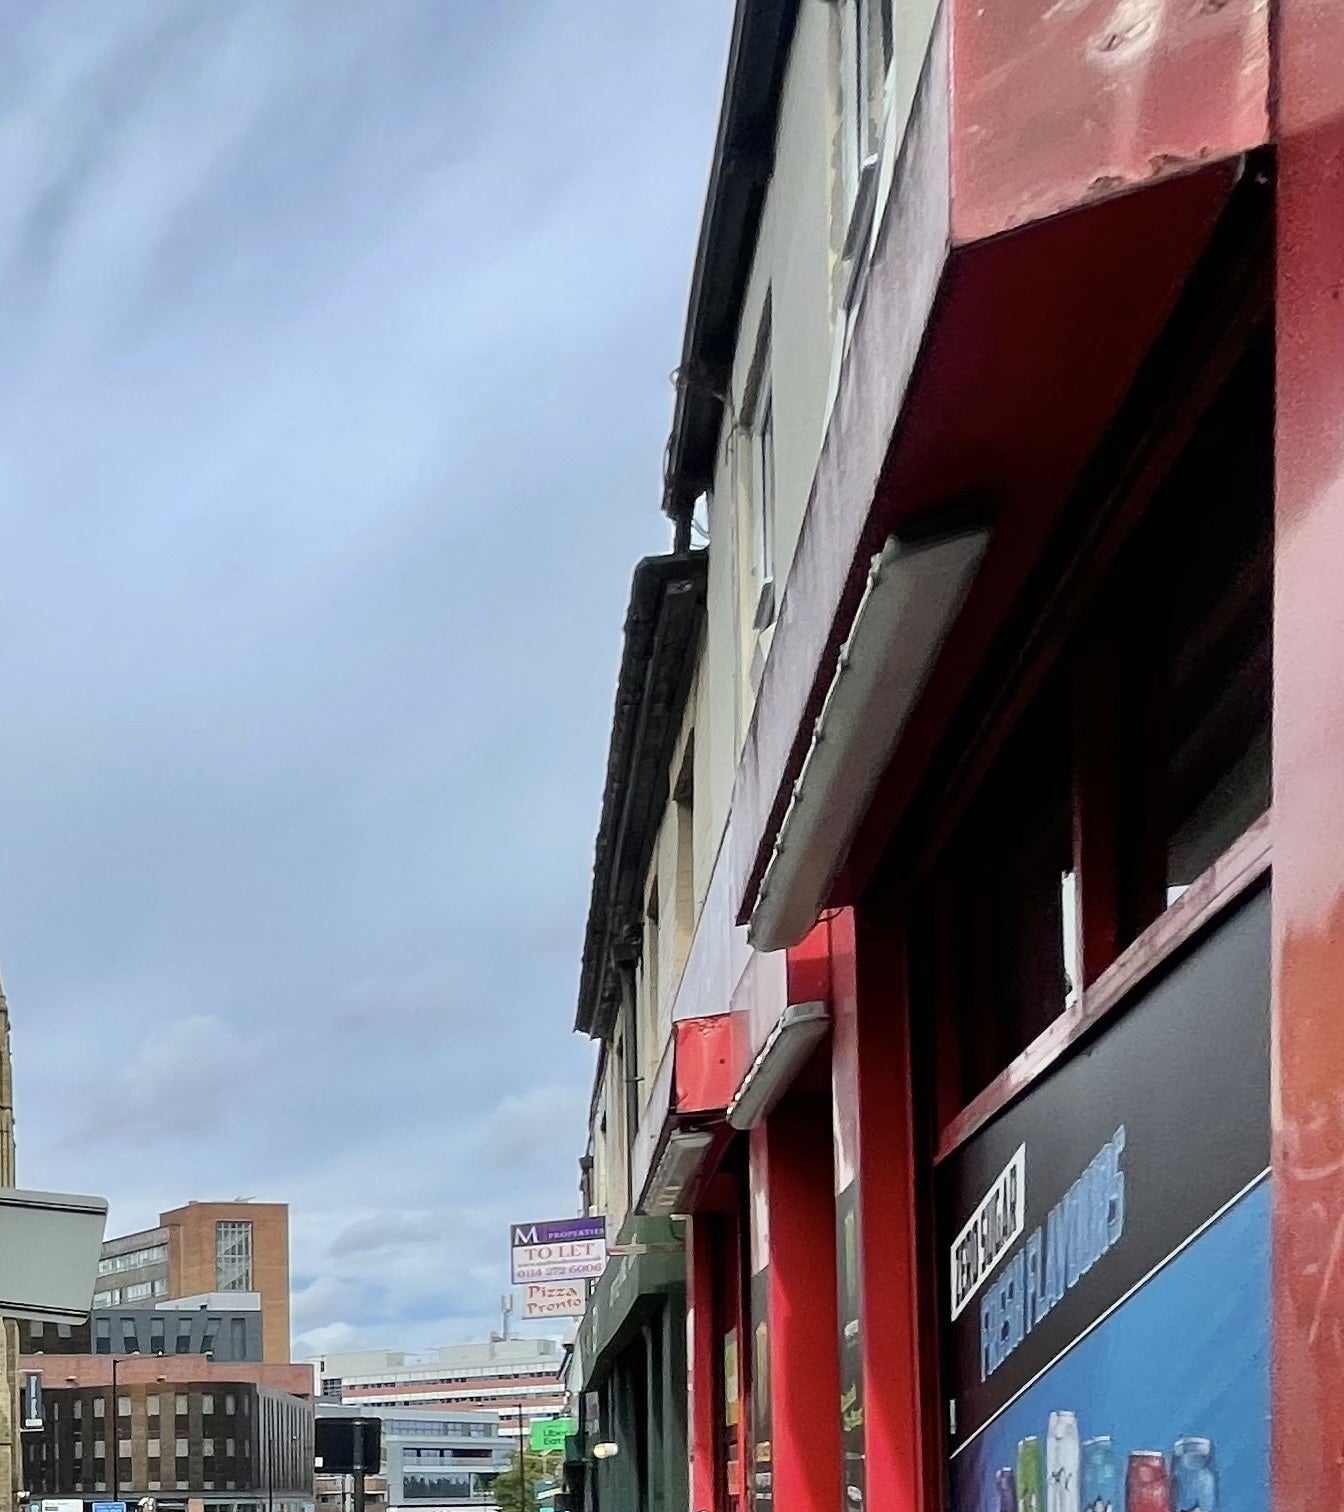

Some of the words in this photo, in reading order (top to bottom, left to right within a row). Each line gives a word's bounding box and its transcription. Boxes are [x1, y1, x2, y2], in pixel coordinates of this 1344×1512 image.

[981, 1163, 1017, 1276] SUGAR
[525, 1248, 552, 1260] TO
[559, 1244, 595, 1257] LET
[517, 1269, 543, 1279] 0114
[529, 1286, 577, 1298] Pizza
[527, 1299, 582, 1314] Pronto
